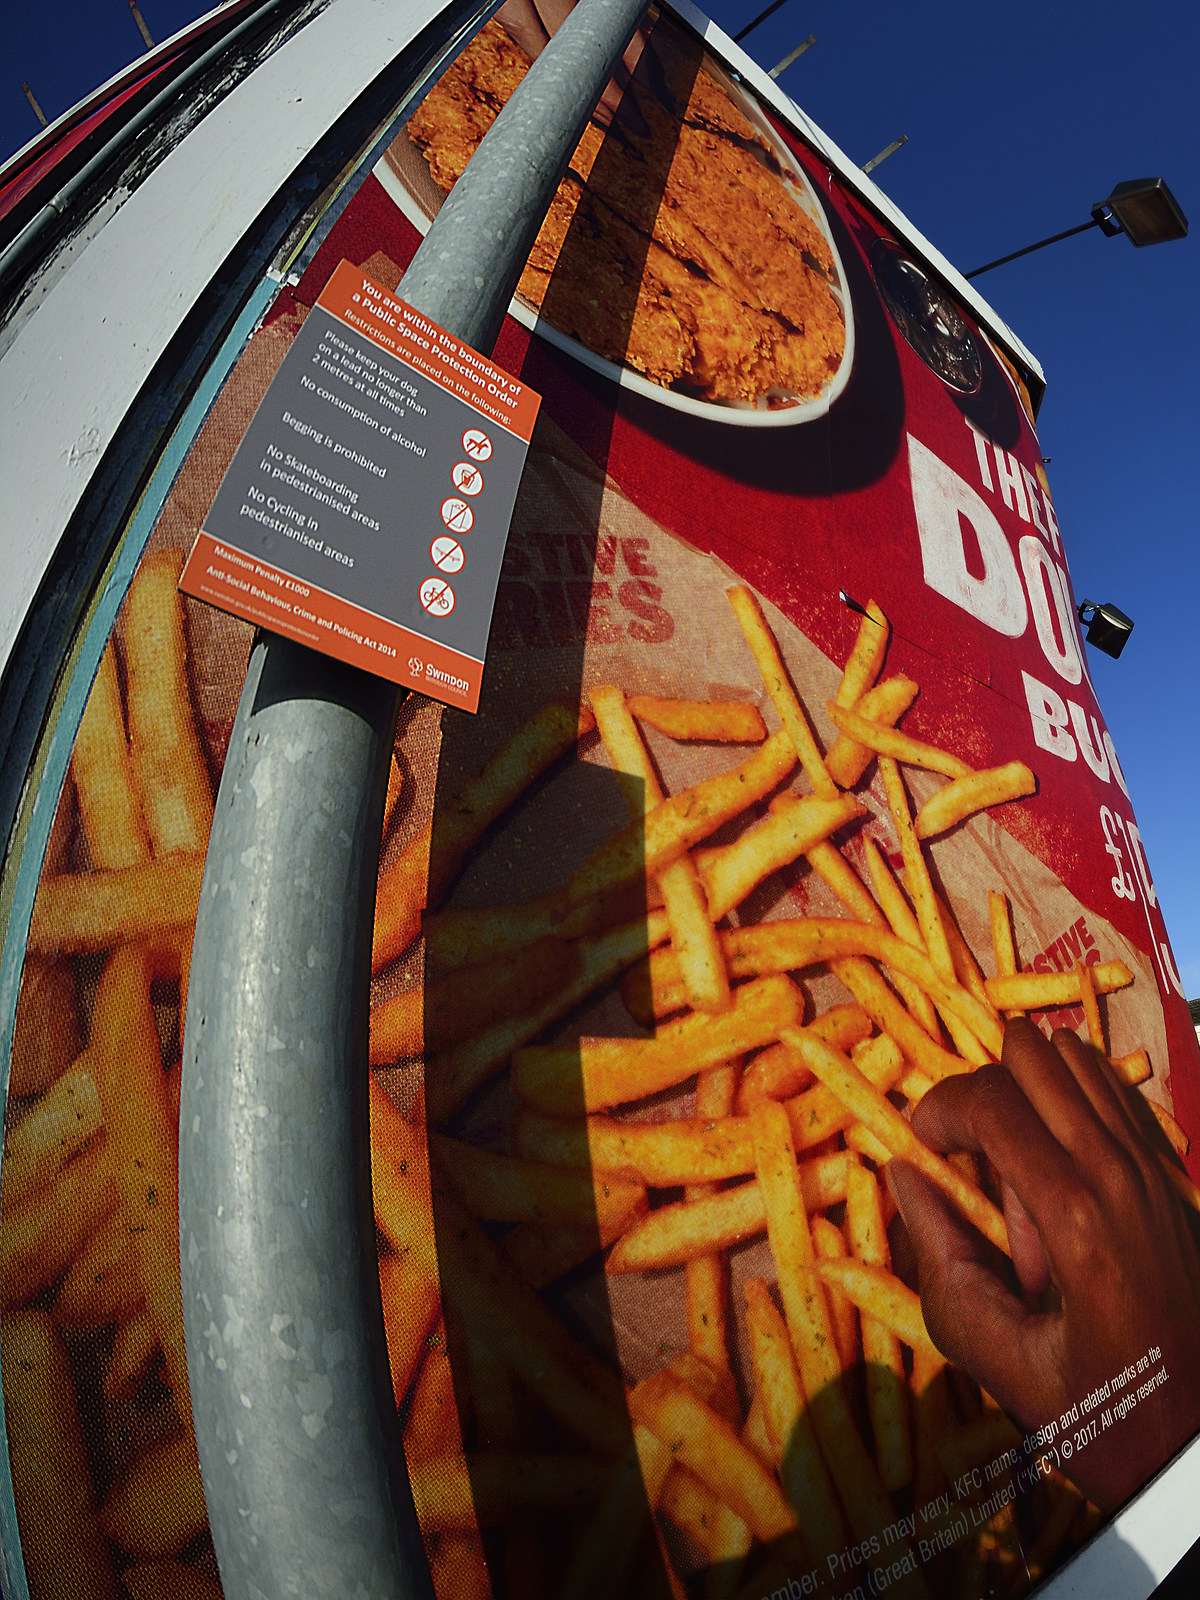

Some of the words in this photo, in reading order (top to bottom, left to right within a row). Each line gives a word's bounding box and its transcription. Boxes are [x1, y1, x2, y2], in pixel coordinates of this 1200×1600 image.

[323, 329, 355, 355] Please
[354, 348, 378, 370] keep
[377, 365, 400, 384] your
[399, 380, 418, 398] dog
[343, 308, 396, 349] Restrictions
[395, 344, 412, 359] are
[410, 354, 443, 379] placed
[441, 374, 455, 387] on
[454, 382, 470, 397] the
[470, 391, 511, 425] following:
[351, 292, 361, 303] a
[360, 296, 397, 327] Public
[395, 321, 430, 350] Space
[429, 343, 486, 388] Protection
[486, 382, 518, 409] Order
[361, 278, 382, 300] You
[381, 296, 402, 314] are
[402, 309, 438, 339] within
[437, 333, 458, 353] the
[457, 345, 509, 388] boundary
[507, 382, 522, 396] of
[311, 352, 321, 364] 2
[319, 359, 354, 385] metres
[353, 381, 366, 392] at
[365, 388, 379, 400] all
[378, 394, 405, 417] times
[317, 342, 332, 356] on
[331, 352, 340, 361] a
[339, 354, 362, 374] lead
[360, 369, 375, 383] no
[374, 376, 406, 401] longer
[405, 396, 427, 416] than
[281, 410, 323, 444] Begging
[322, 434, 332, 448] is
[332, 442, 387, 478] prohibited
[299, 374, 316, 391] No
[315, 386, 379, 430] consumption
[378, 424, 392, 436] of
[390, 431, 427, 458] alcohol
[246, 485, 265, 503] No
[265, 495, 306, 527] Cycling
[306, 515, 319, 531] in
[258, 458, 271, 473] in
[270, 466, 351, 515] pedestrianised
[350, 509, 380, 531] areas
[265, 443, 283, 461] No
[283, 453, 359, 504] Skateboarding
[212, 544, 255, 572] Maximum
[253, 564, 285, 587] Penalty
[238, 503, 324, 552] pedestrianised
[323, 545, 354, 568] areas
[291, 604, 318, 623] Crime
[315, 617, 333, 630] and
[332, 622, 363, 645] Policing
[362, 636, 377, 649] Act
[376, 641, 397, 658] 2014
[759, 1569, 825, 1600] mber.
[826, 1535, 881, 1580] Prices
[882, 1512, 917, 1546] may
[919, 1492, 954, 1524] vary.
[953, 1467, 983, 1501] KFC
[984, 1447, 1023, 1483] name,
[1023, 1420, 1060, 1455] design
[1059, 1402, 1079, 1430] and
[1079, 1380, 1111, 1416] related
[1110, 1365, 1137, 1393] marks
[1136, 1354, 1150, 1374] are
[1148, 1346, 1163, 1364] the
[867, 1549, 919, 1598] (Great
[918, 1511, 969, 1563] Britain)
[969, 1479, 1017, 1527] Limited
[1073, 1419, 1102, 1452] 2017.
[1100, 1408, 1114, 1431] All
[1113, 1393, 1137, 1420] rights
[1136, 1365, 1170, 1402] reserved.
